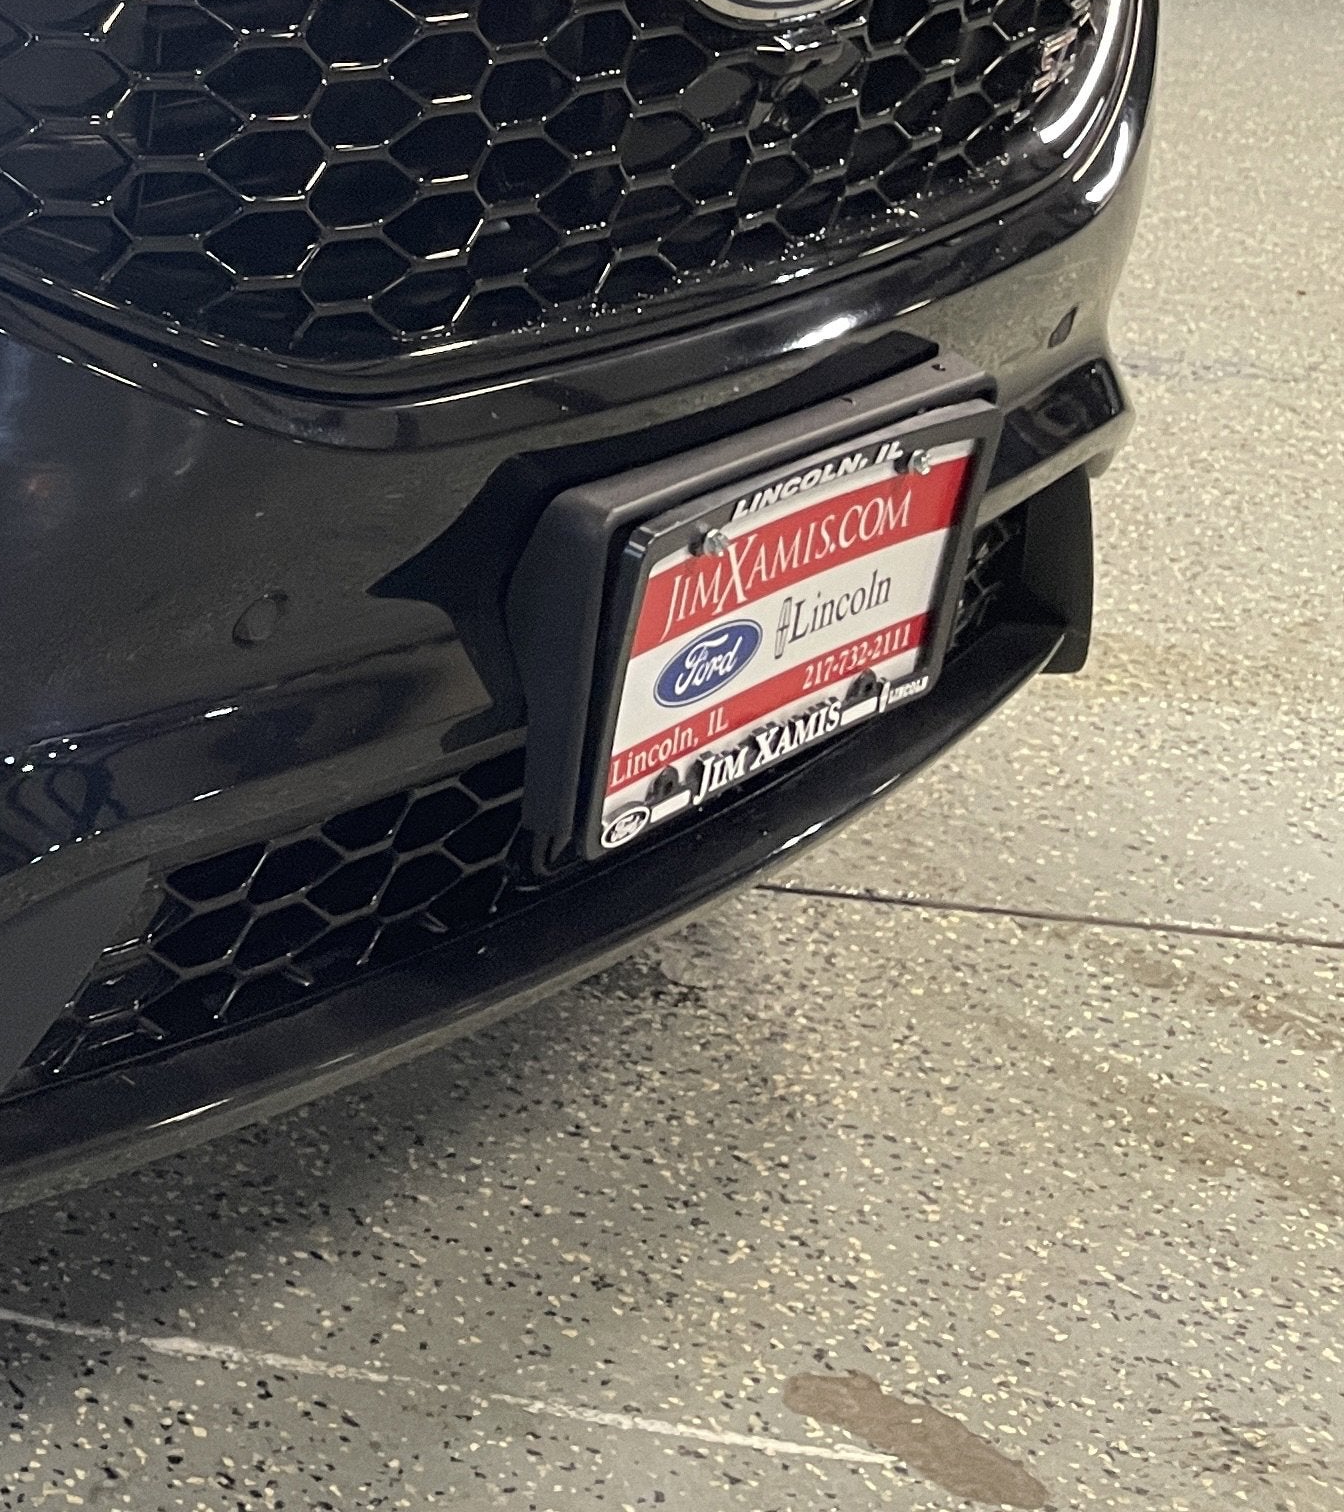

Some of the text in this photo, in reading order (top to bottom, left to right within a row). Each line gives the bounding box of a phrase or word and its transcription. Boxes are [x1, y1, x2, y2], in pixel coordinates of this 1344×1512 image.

[731, 441, 904, 522] LINCOLN, IL
[660, 489, 912, 642] JIMXAMIS.COM
[788, 569, 892, 644] Lincoln
[675, 634, 742, 695] Ford
[802, 624, 911, 689] 217-732-2111
[610, 706, 728, 788] Lincoln, IL
[692, 701, 842, 806] JIM XAMIS
